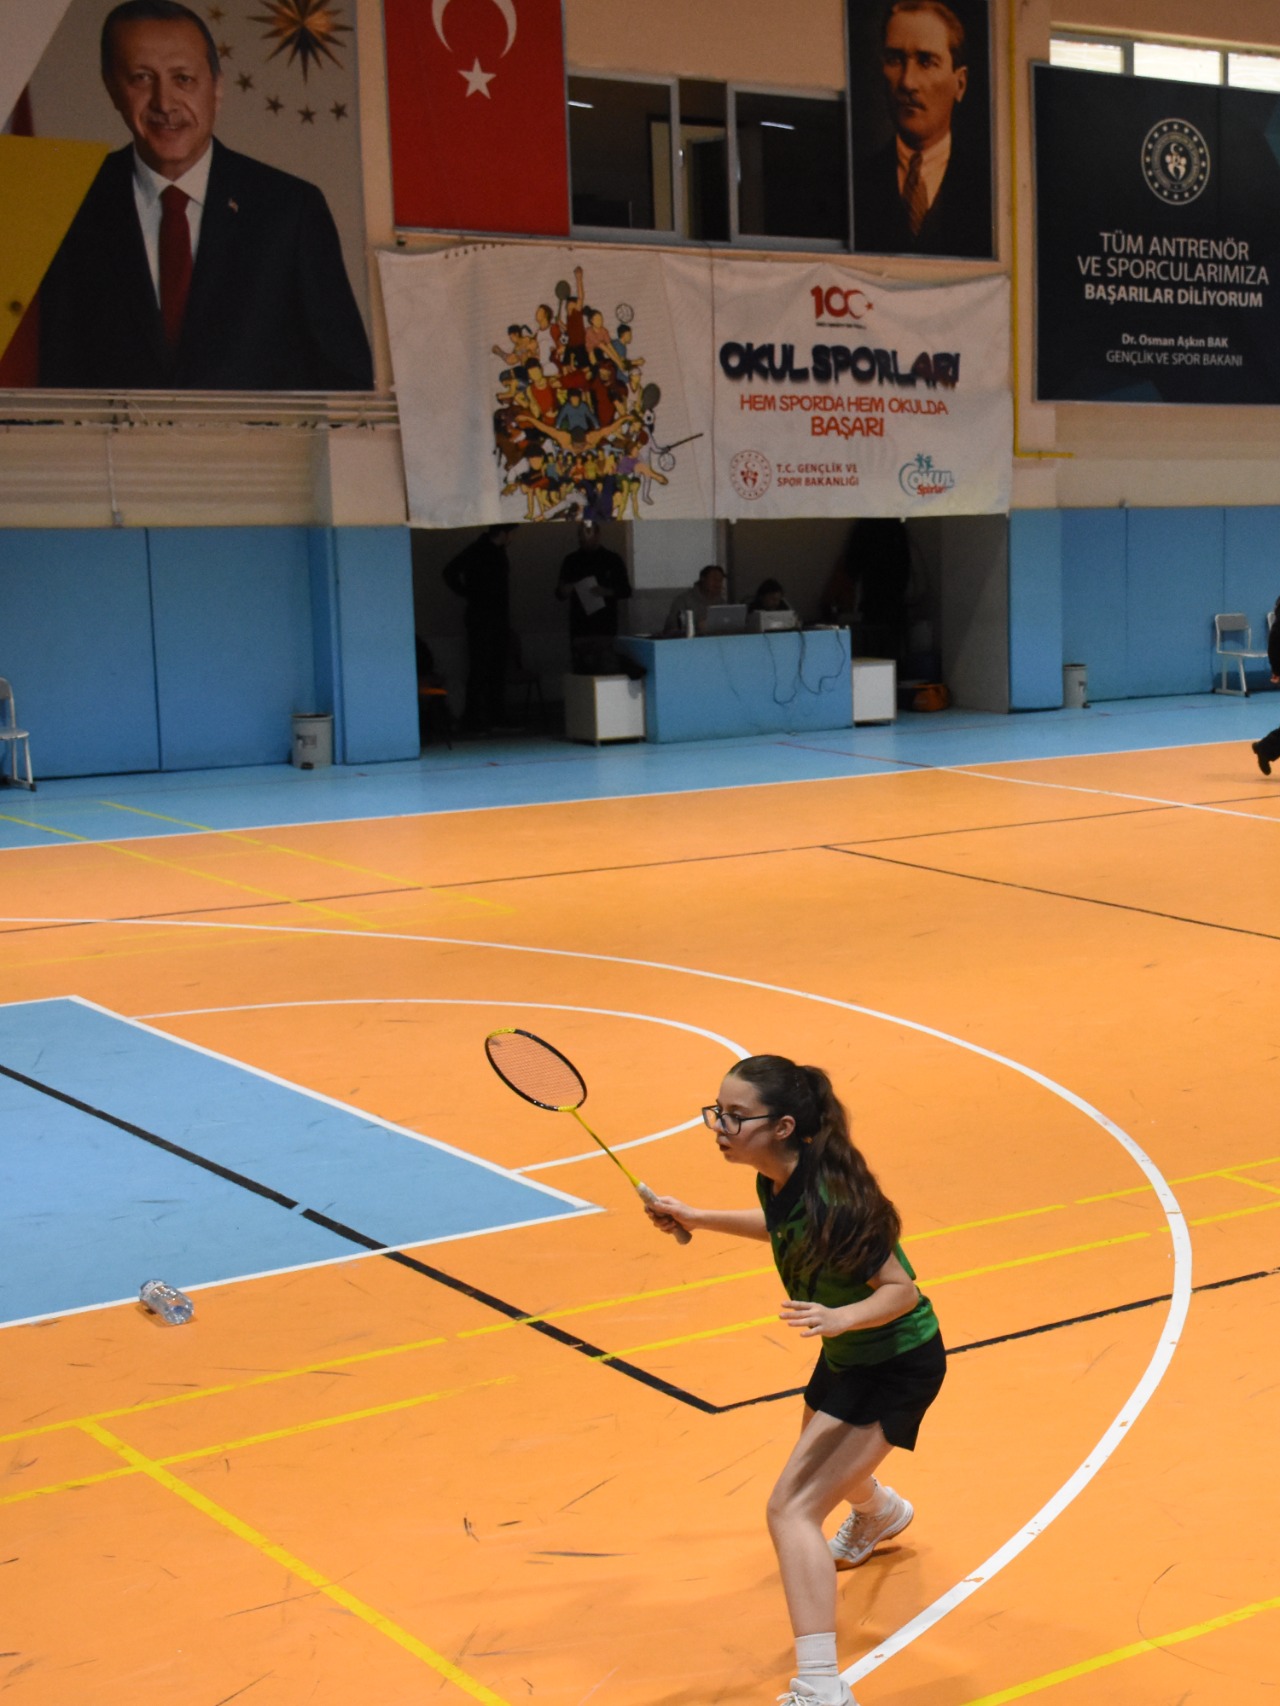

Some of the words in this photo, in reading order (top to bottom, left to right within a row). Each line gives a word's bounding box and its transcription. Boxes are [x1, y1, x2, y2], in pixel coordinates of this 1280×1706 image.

[1099, 229, 1144, 255] TÜM
[1149, 236, 1250, 262] ANTRENÖR
[1076, 255, 1102, 277] VE
[1106, 256, 1270, 286] SPORCULARIMIZA
[1084, 283, 1174, 306] BAŞARILAR
[1177, 285, 1263, 308] DİLİYORUM
[1121, 333, 1137, 345] Dr.
[1139, 334, 1175, 346] Osman
[1177, 336, 1205, 349] Aşkın
[1207, 337, 1229, 348] BAK
[719, 341, 809, 384] OKUL
[811, 344, 961, 390] SPORLARI
[1106, 350, 1152, 366] GENÇLİK
[1152, 352, 1170, 365] VE
[1171, 353, 1200, 365] SPOR
[1202, 354, 1243, 367] BAKANI
[740, 393, 776, 411] HEM
[779, 396, 846, 412] SPORDA
[847, 396, 884, 413] HEM
[888, 398, 949, 415] OKULDA
[811, 416, 885, 440] BAŞARI
[776, 463, 795, 473] T.C.
[797, 461, 842, 477] GENÇLİK
[846, 463, 858, 473] VE
[908, 470, 955, 489] OKUL
[777, 476, 801, 487] SPOR
[804, 476, 859, 487] BAKANLIĞI
